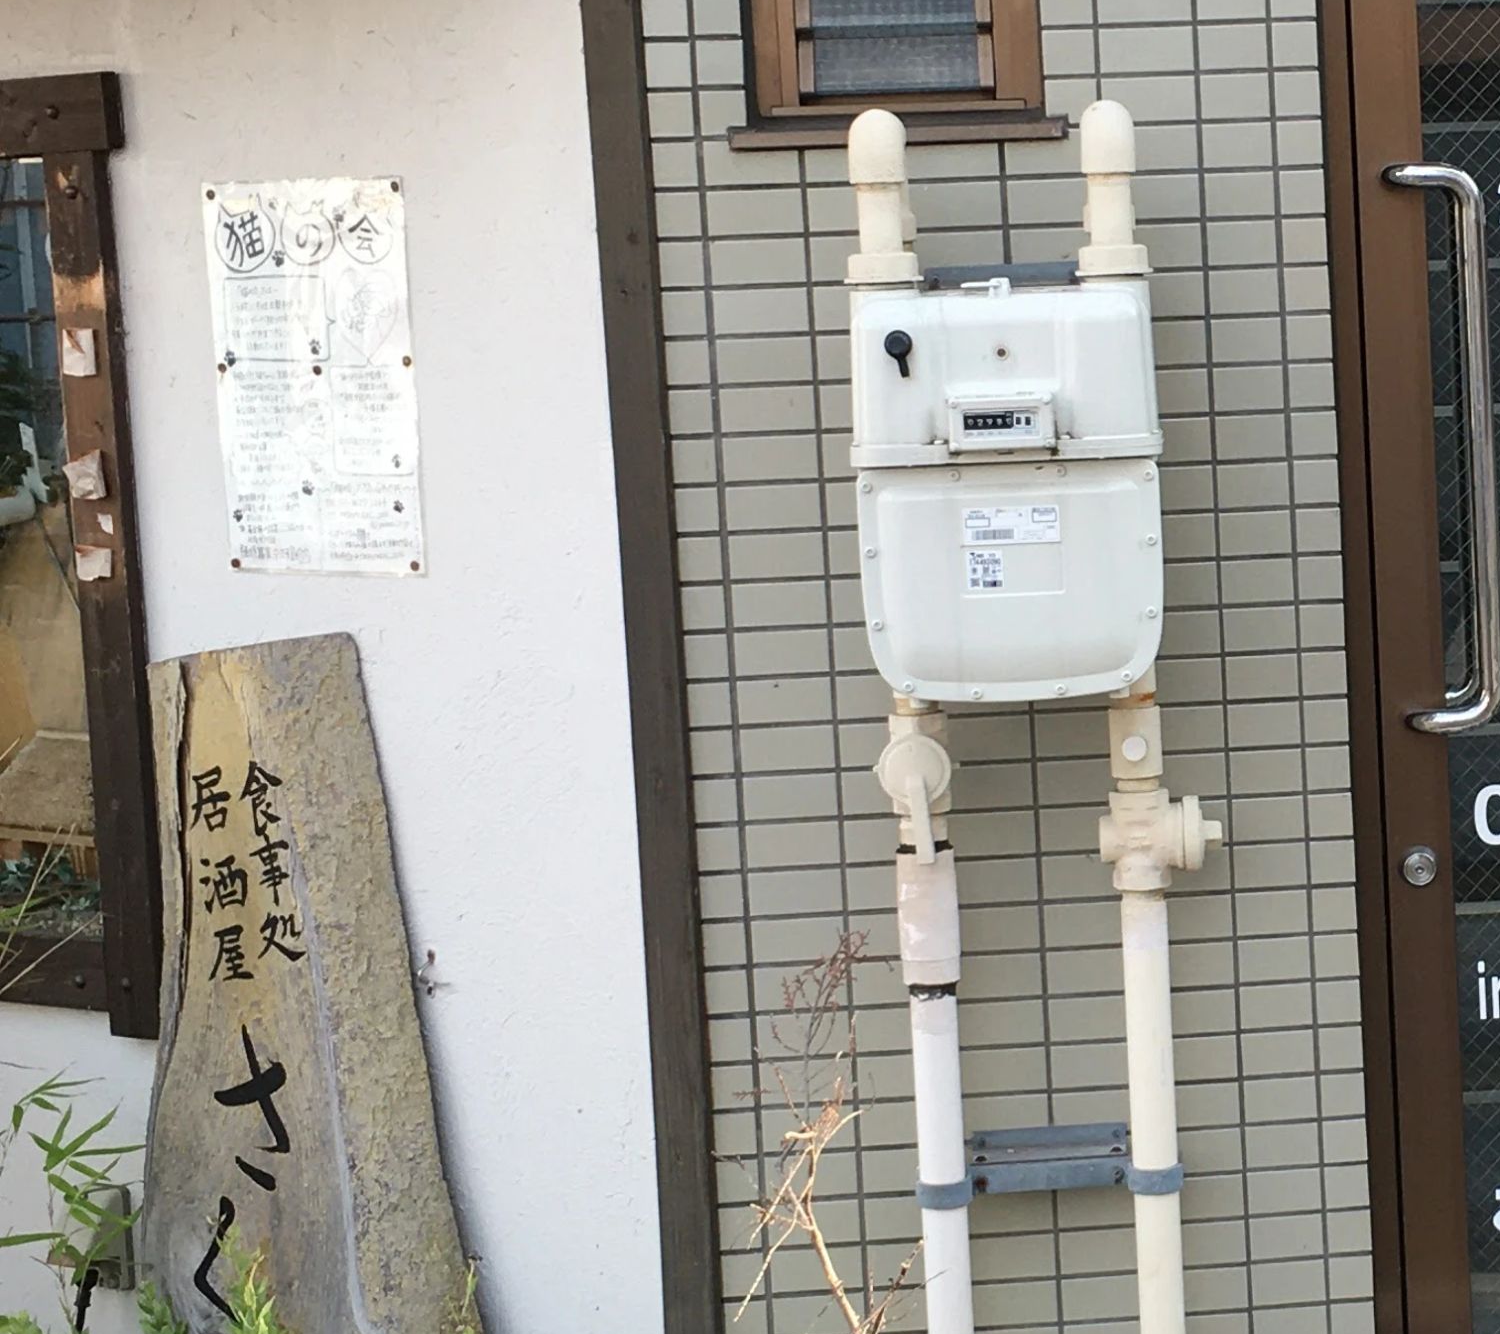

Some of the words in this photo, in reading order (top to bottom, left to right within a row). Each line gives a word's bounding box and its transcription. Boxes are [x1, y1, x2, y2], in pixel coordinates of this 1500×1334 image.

[223, 211, 381, 268] 猫の会
[190, 764, 254, 983] 居酒屋
[238, 761, 306, 962] 食事処
